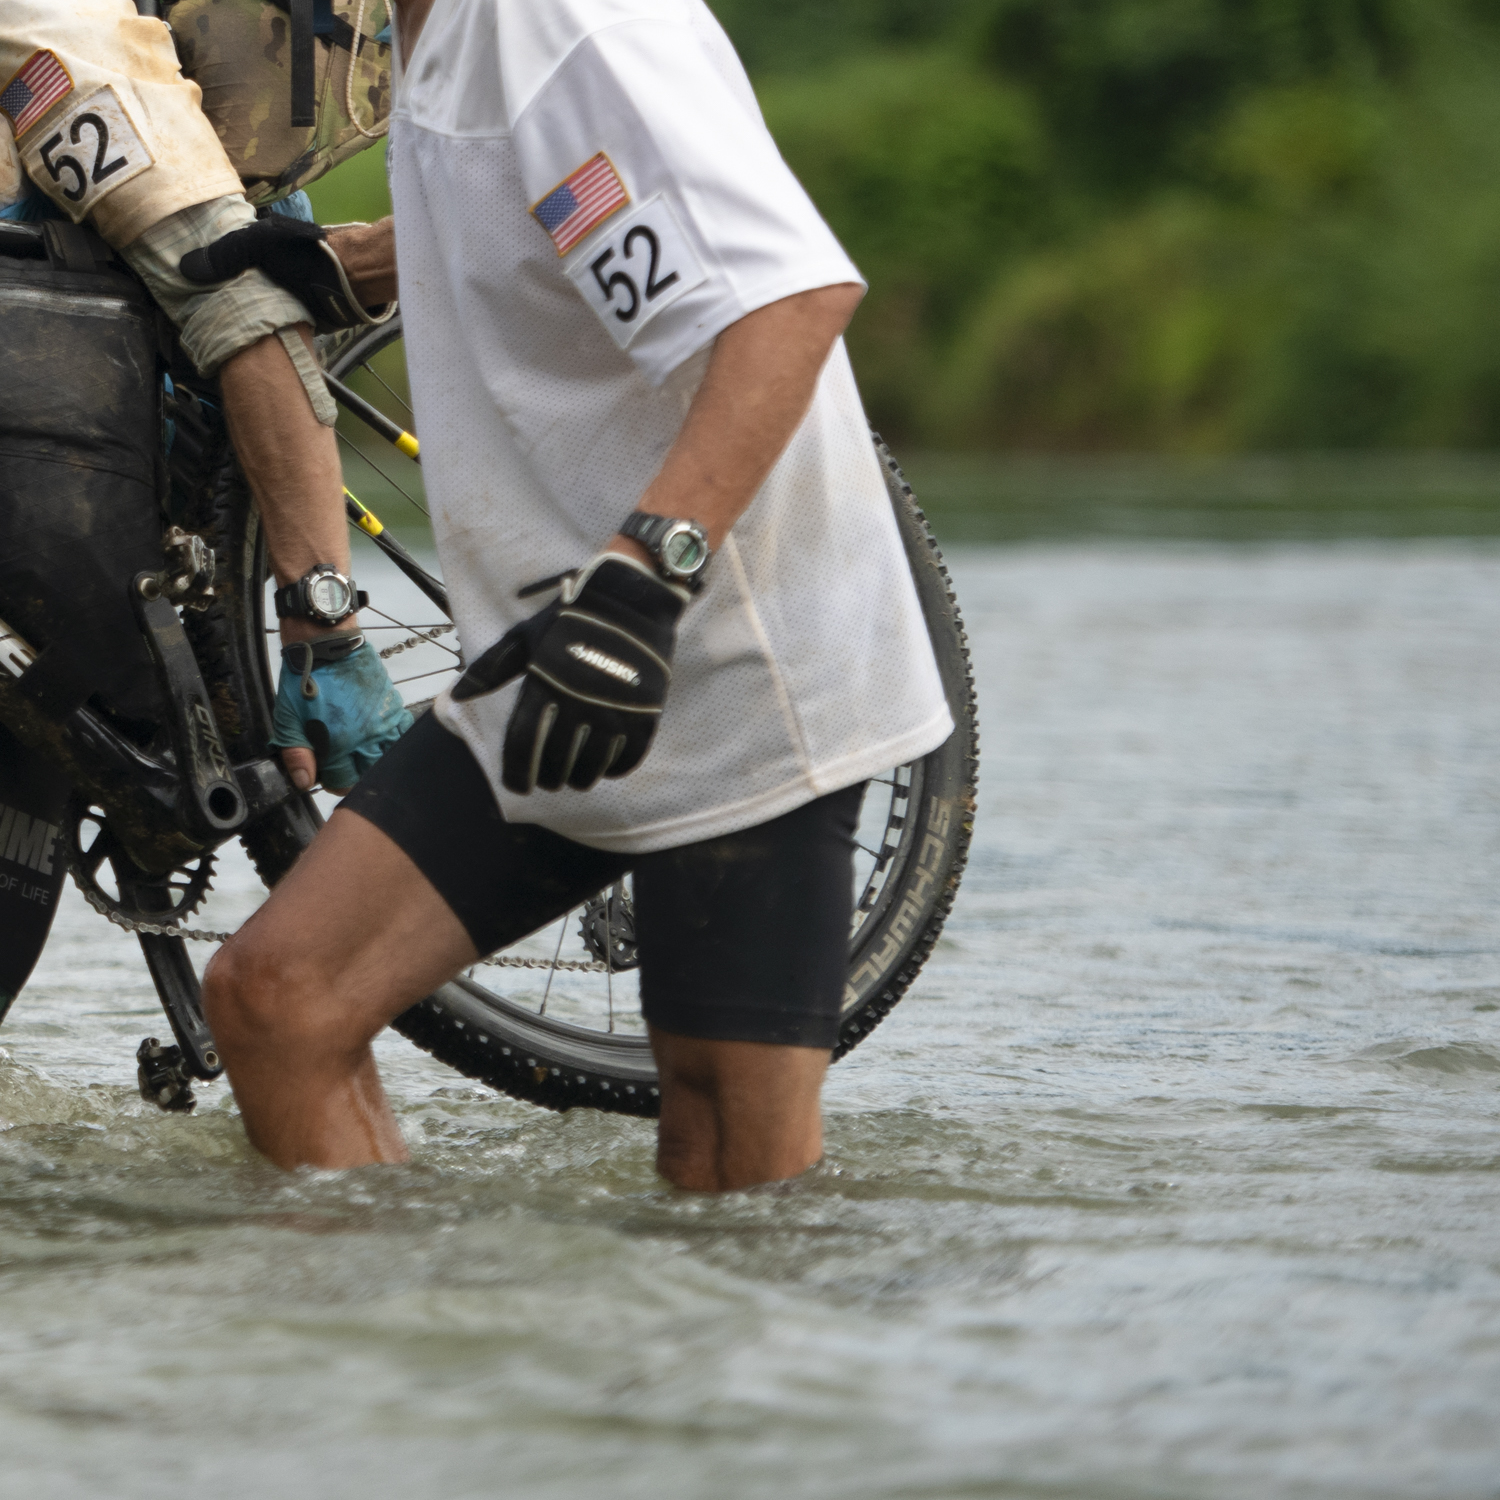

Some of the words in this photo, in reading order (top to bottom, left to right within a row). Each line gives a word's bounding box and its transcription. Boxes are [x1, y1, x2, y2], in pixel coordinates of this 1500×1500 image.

[39, 112, 129, 202] 52
[590, 224, 681, 324] 52
[584, 650, 639, 682] HUSKY
[21, 882, 51, 906] LIFE
[840, 795, 951, 1014] SCHWALB
